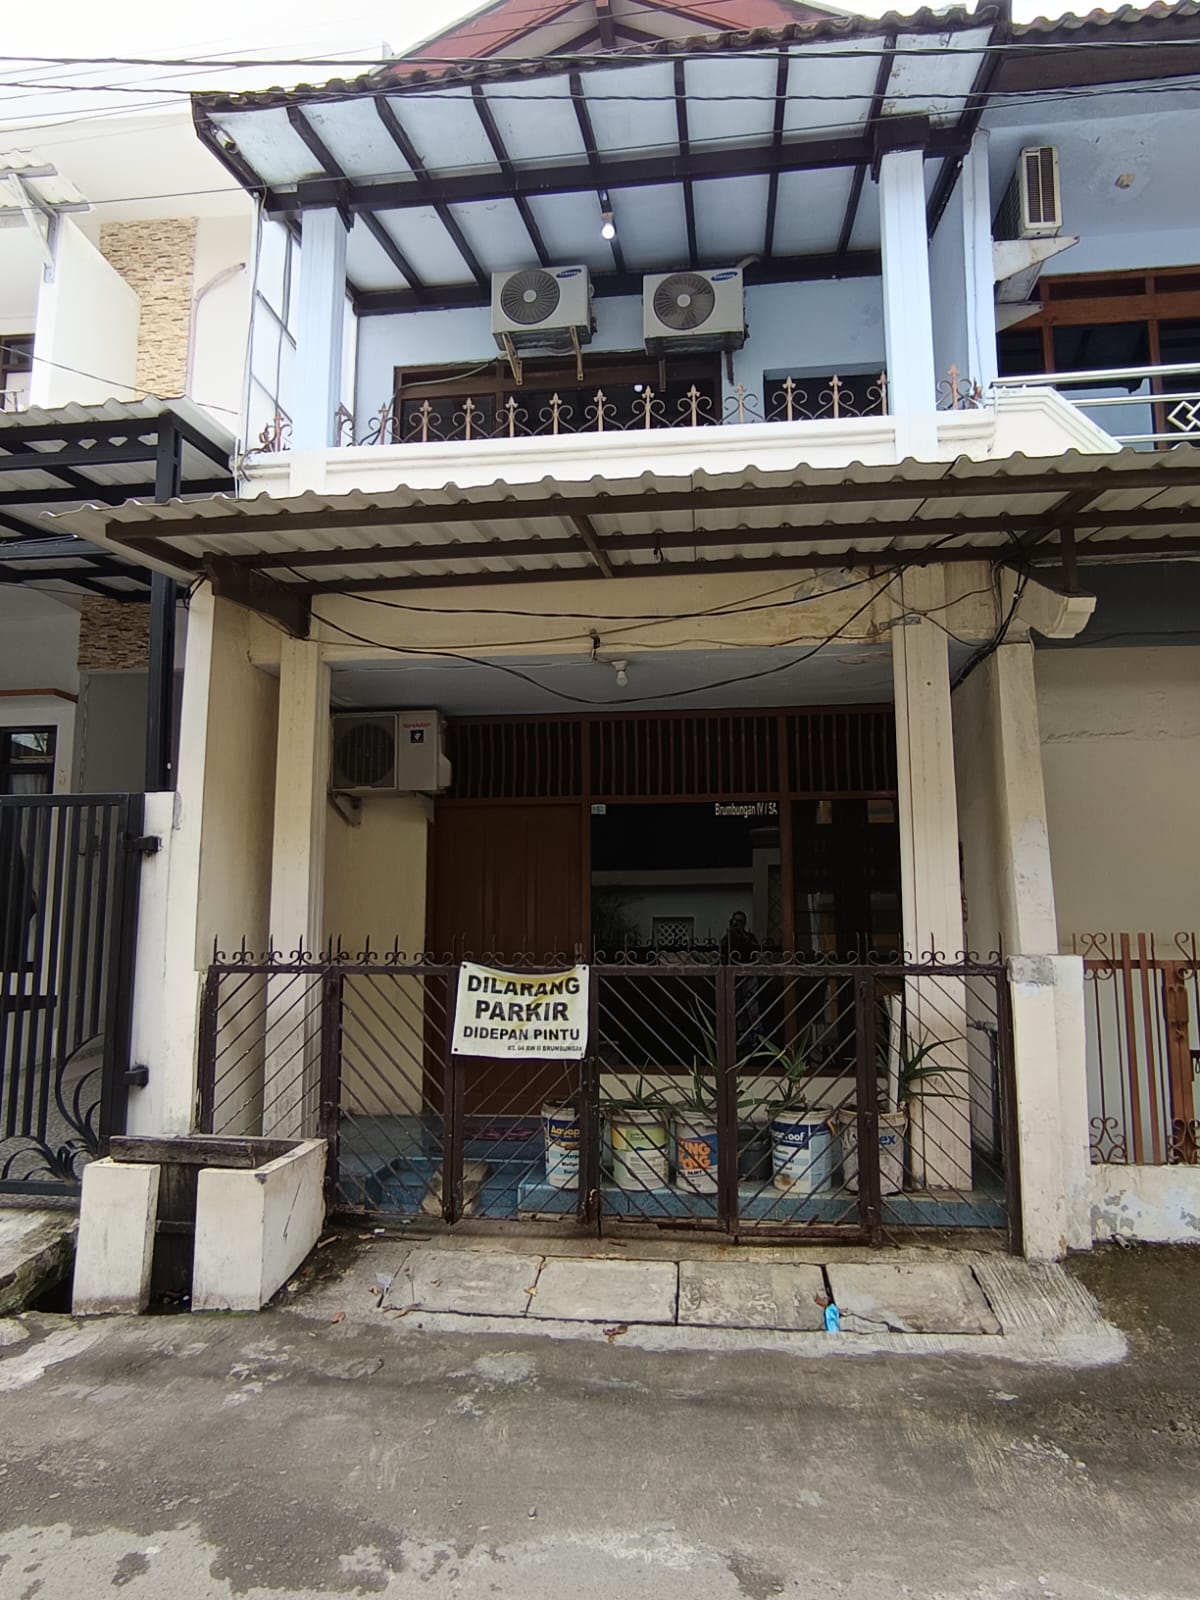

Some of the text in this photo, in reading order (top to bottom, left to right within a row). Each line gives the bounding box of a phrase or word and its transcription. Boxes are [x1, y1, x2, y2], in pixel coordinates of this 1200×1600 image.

[467, 975, 580, 997] DILARANG
[475, 1000, 569, 1022] PARKIR
[463, 1026, 580, 1040] DIDEPAN PINTU
